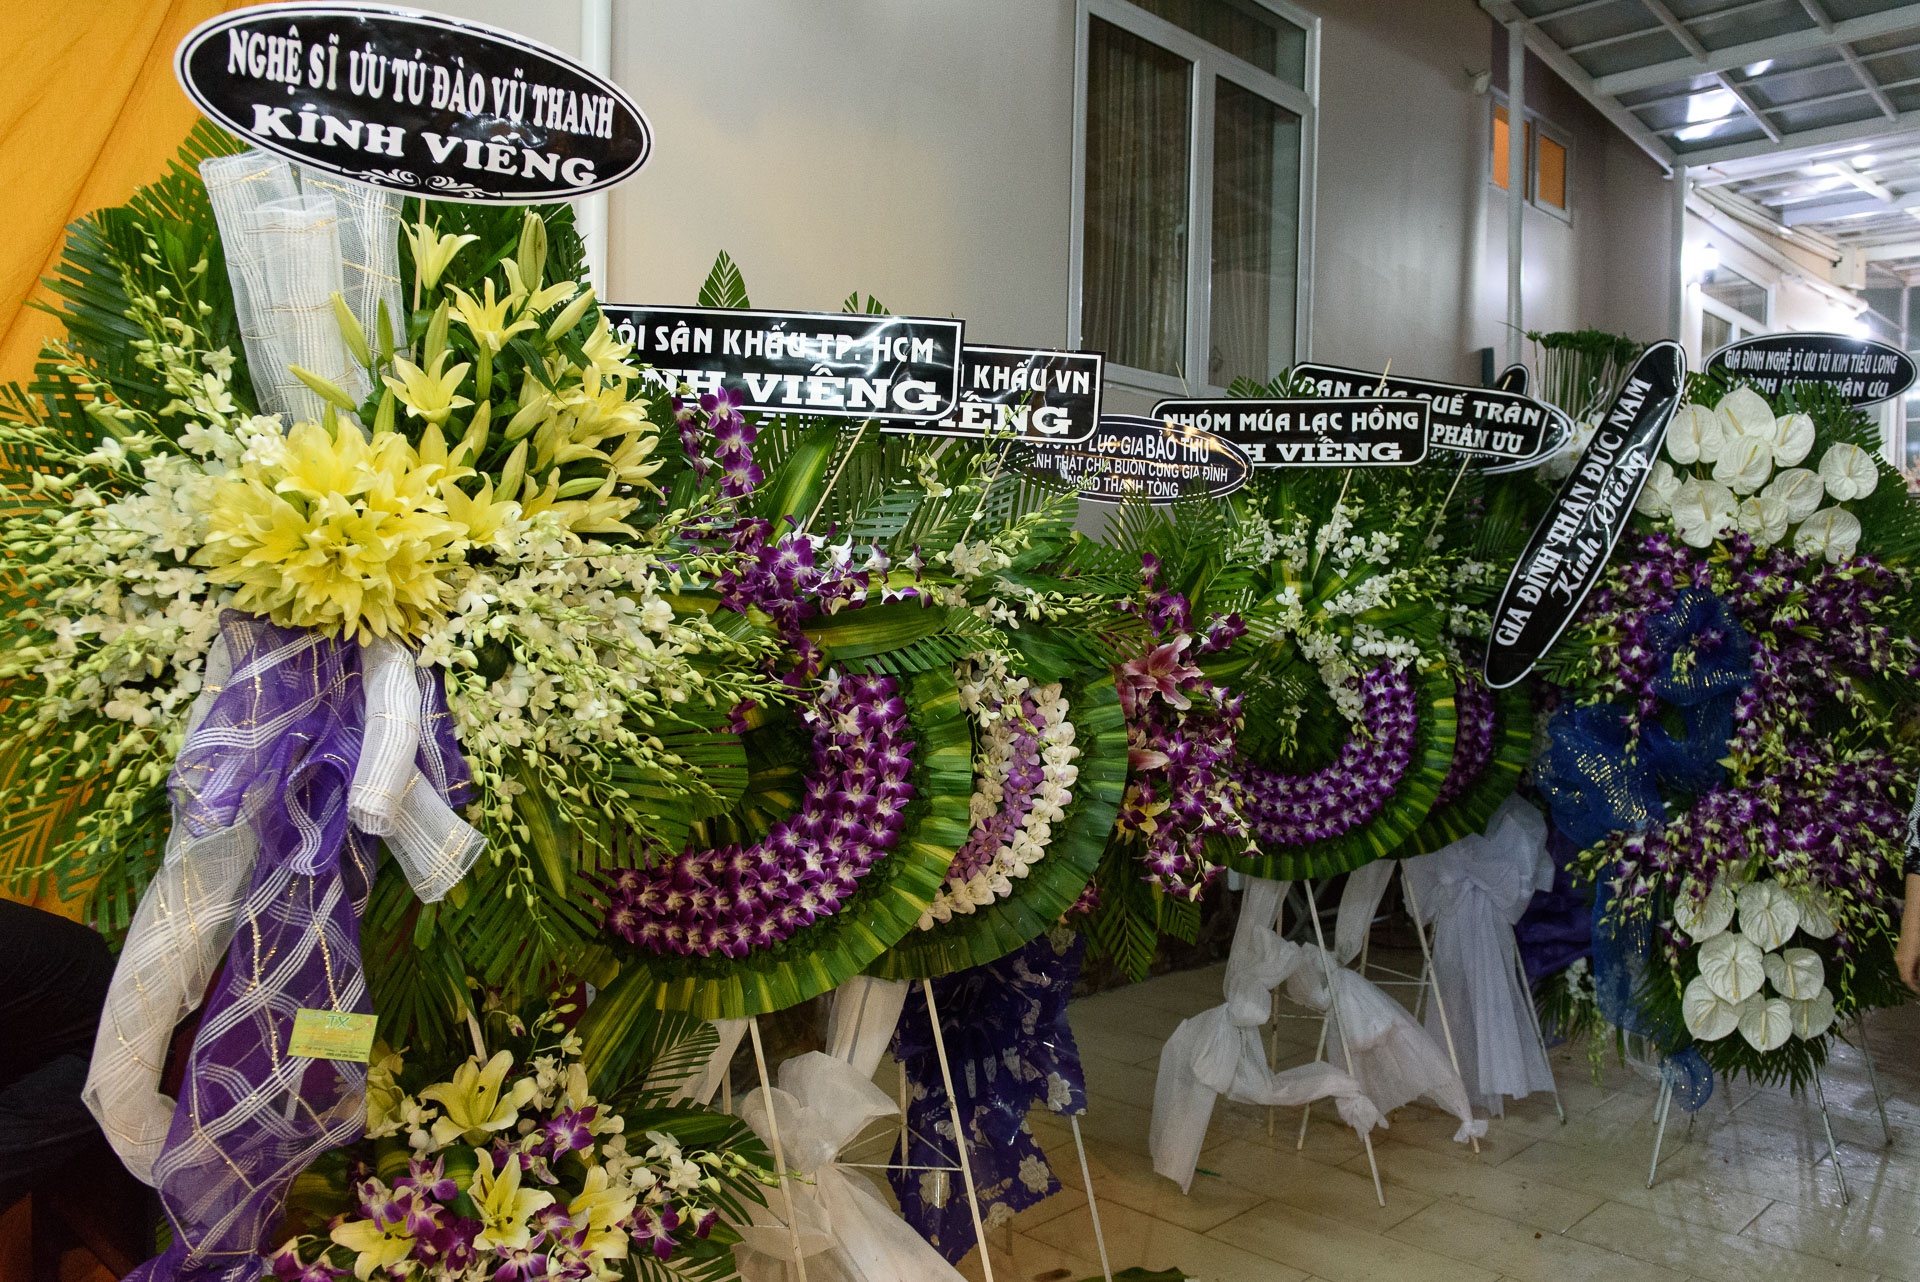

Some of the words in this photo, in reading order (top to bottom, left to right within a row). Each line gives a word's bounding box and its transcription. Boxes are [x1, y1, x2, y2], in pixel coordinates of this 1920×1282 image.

[227, 24, 303, 95] NGHỆ
[308, 32, 340, 91] SĨ
[349, 40, 385, 100] ƯU
[390, 48, 424, 105] TÚ
[431, 57, 484, 116] ĐÀO
[491, 66, 526, 119] VŨ
[531, 84, 615, 140] THANH
[251, 103, 407, 158] KÍNH
[420, 131, 599, 188] VIẾNG
[655, 320, 713, 355] SÂN
[722, 322, 807, 359] KHẤU
[872, 336, 934, 363] HCM
[973, 358, 1047, 393] KHẤU
[1055, 369, 1090, 395] VN
[1831, 353, 1850, 373] KIM
[1872, 354, 1899, 374] LONG
[742, 363, 943, 412] VIẾNG
[1239, 409, 1290, 432] MÚA
[1299, 412, 1344, 436] LẠC
[1352, 405, 1420, 432] HỒNG
[1416, 392, 1464, 415] UẾ
[1472, 400, 1541, 427] TRÂN
[1121, 436, 1144, 456] GIA
[1146, 430, 1177, 461] BẢO
[1181, 437, 1210, 463] THU
[1276, 436, 1403, 462] VIẾNG
[1430, 422, 1489, 448] PHÂN
[1492, 430, 1524, 453] ƯU
[1182, 465, 1201, 480] GIA
[1202, 463, 1228, 482] ĐÌNH
[1495, 603, 1532, 646] GIA
[1516, 542, 1563, 600] ĐÌNH
[1545, 482, 1595, 546] THÂN
[1581, 431, 1624, 487] ĐỨC
[1611, 378, 1652, 431] NAM
[1551, 538, 1603, 608] Kính
